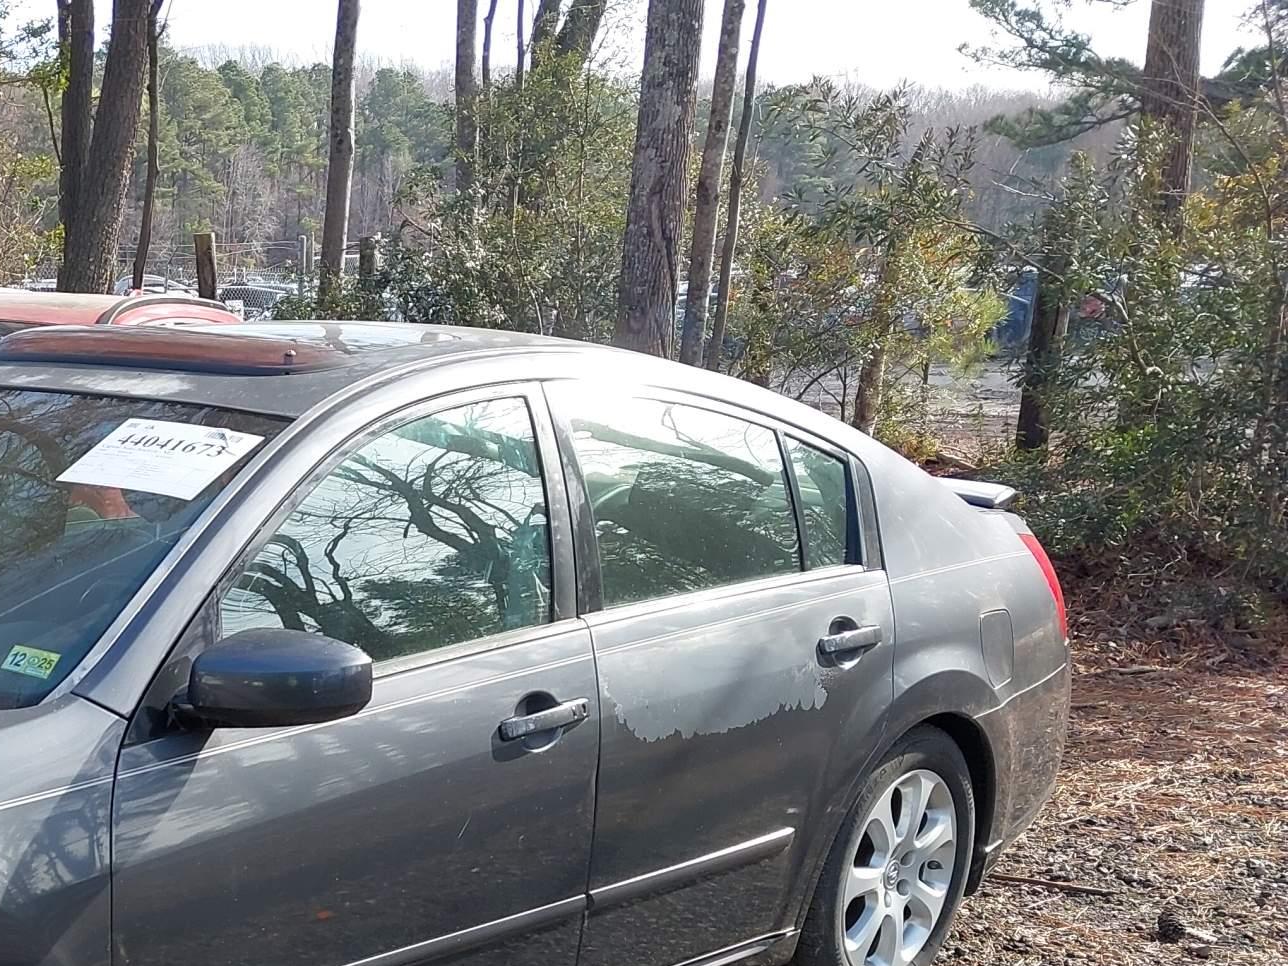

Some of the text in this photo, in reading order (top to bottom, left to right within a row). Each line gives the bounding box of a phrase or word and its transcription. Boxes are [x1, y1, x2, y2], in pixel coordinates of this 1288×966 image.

[117, 433, 226, 457] 44041673
[10, 652, 55, 670] 12 25
